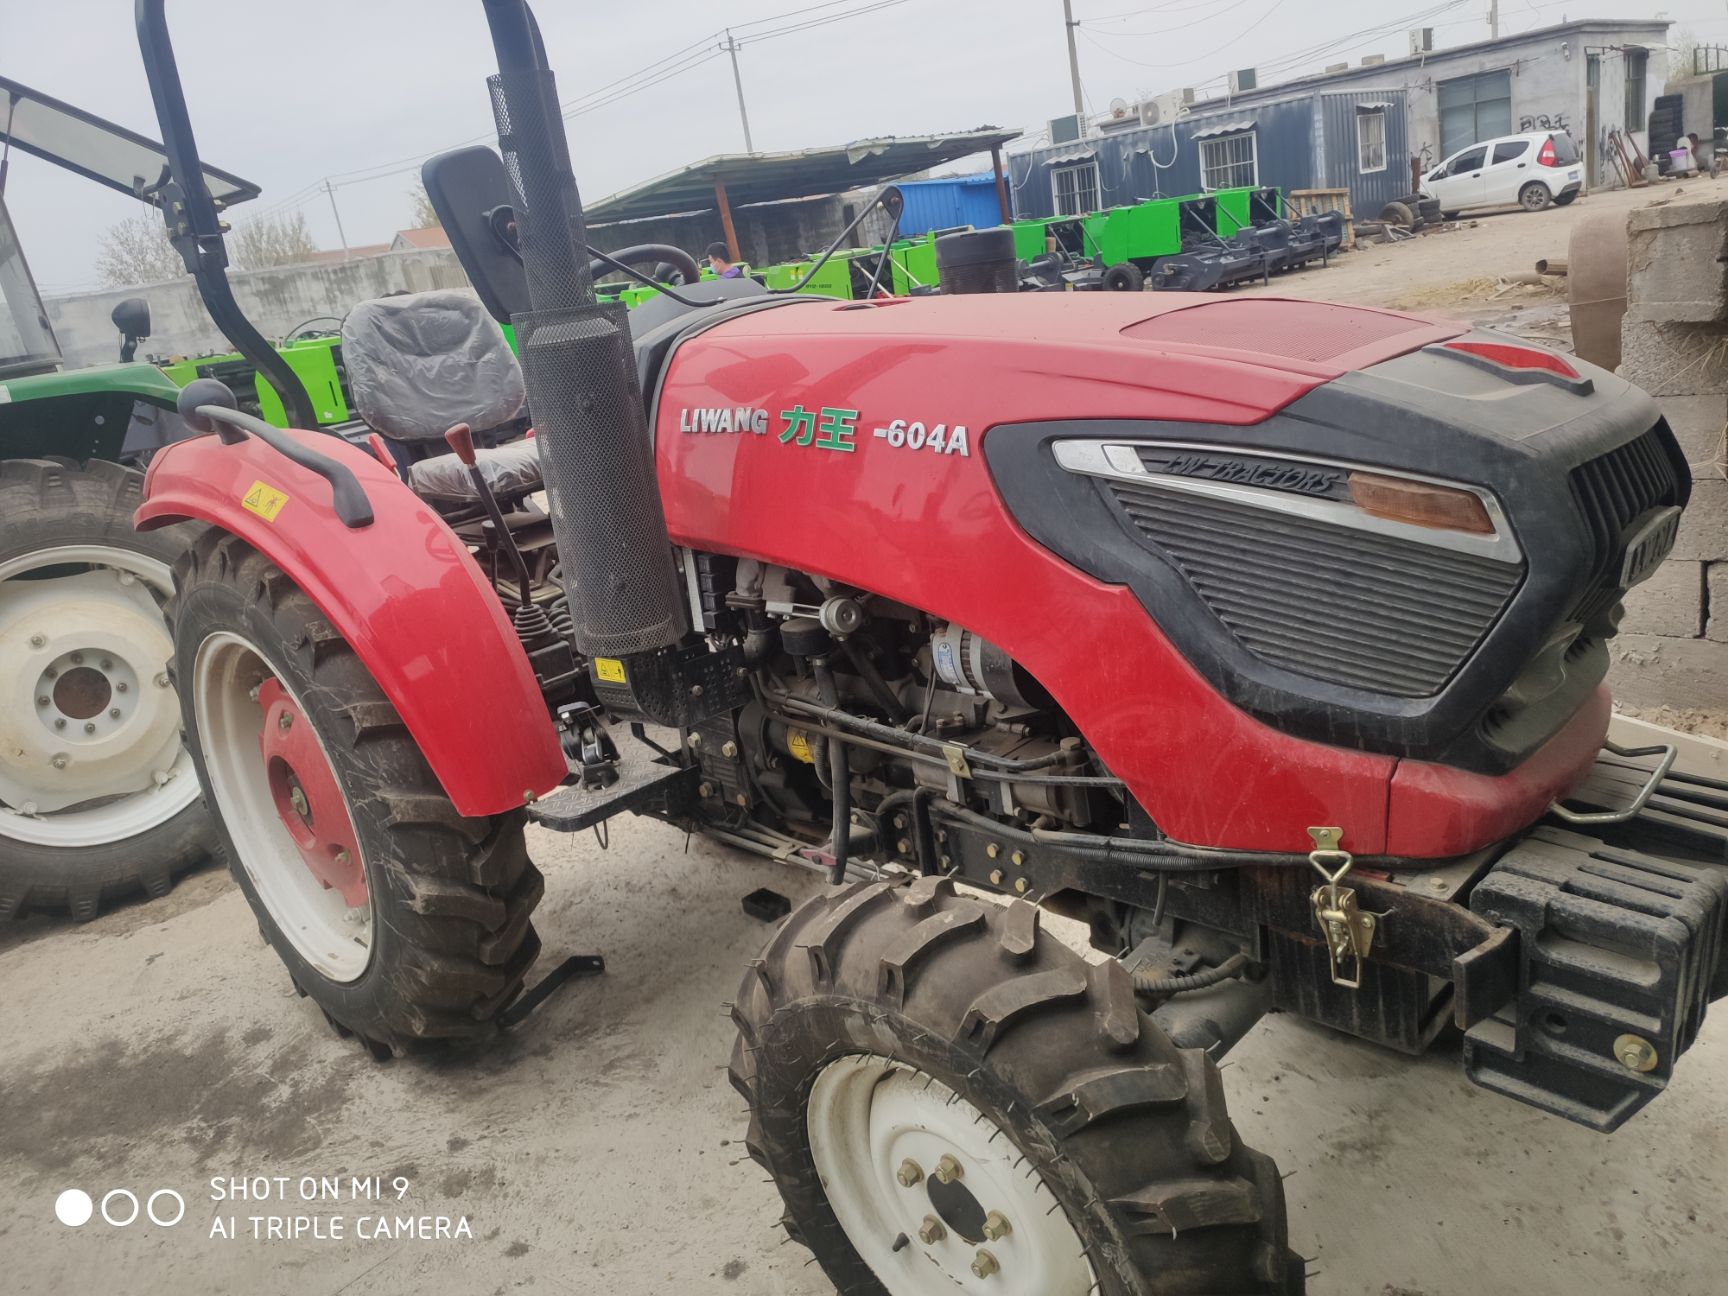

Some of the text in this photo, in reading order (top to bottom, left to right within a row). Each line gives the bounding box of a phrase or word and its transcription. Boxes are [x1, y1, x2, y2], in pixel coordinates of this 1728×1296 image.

[680, 407, 769, 434] LIWANG
[778, 405, 859, 452] 力王
[873, 418, 970, 457] -604A
